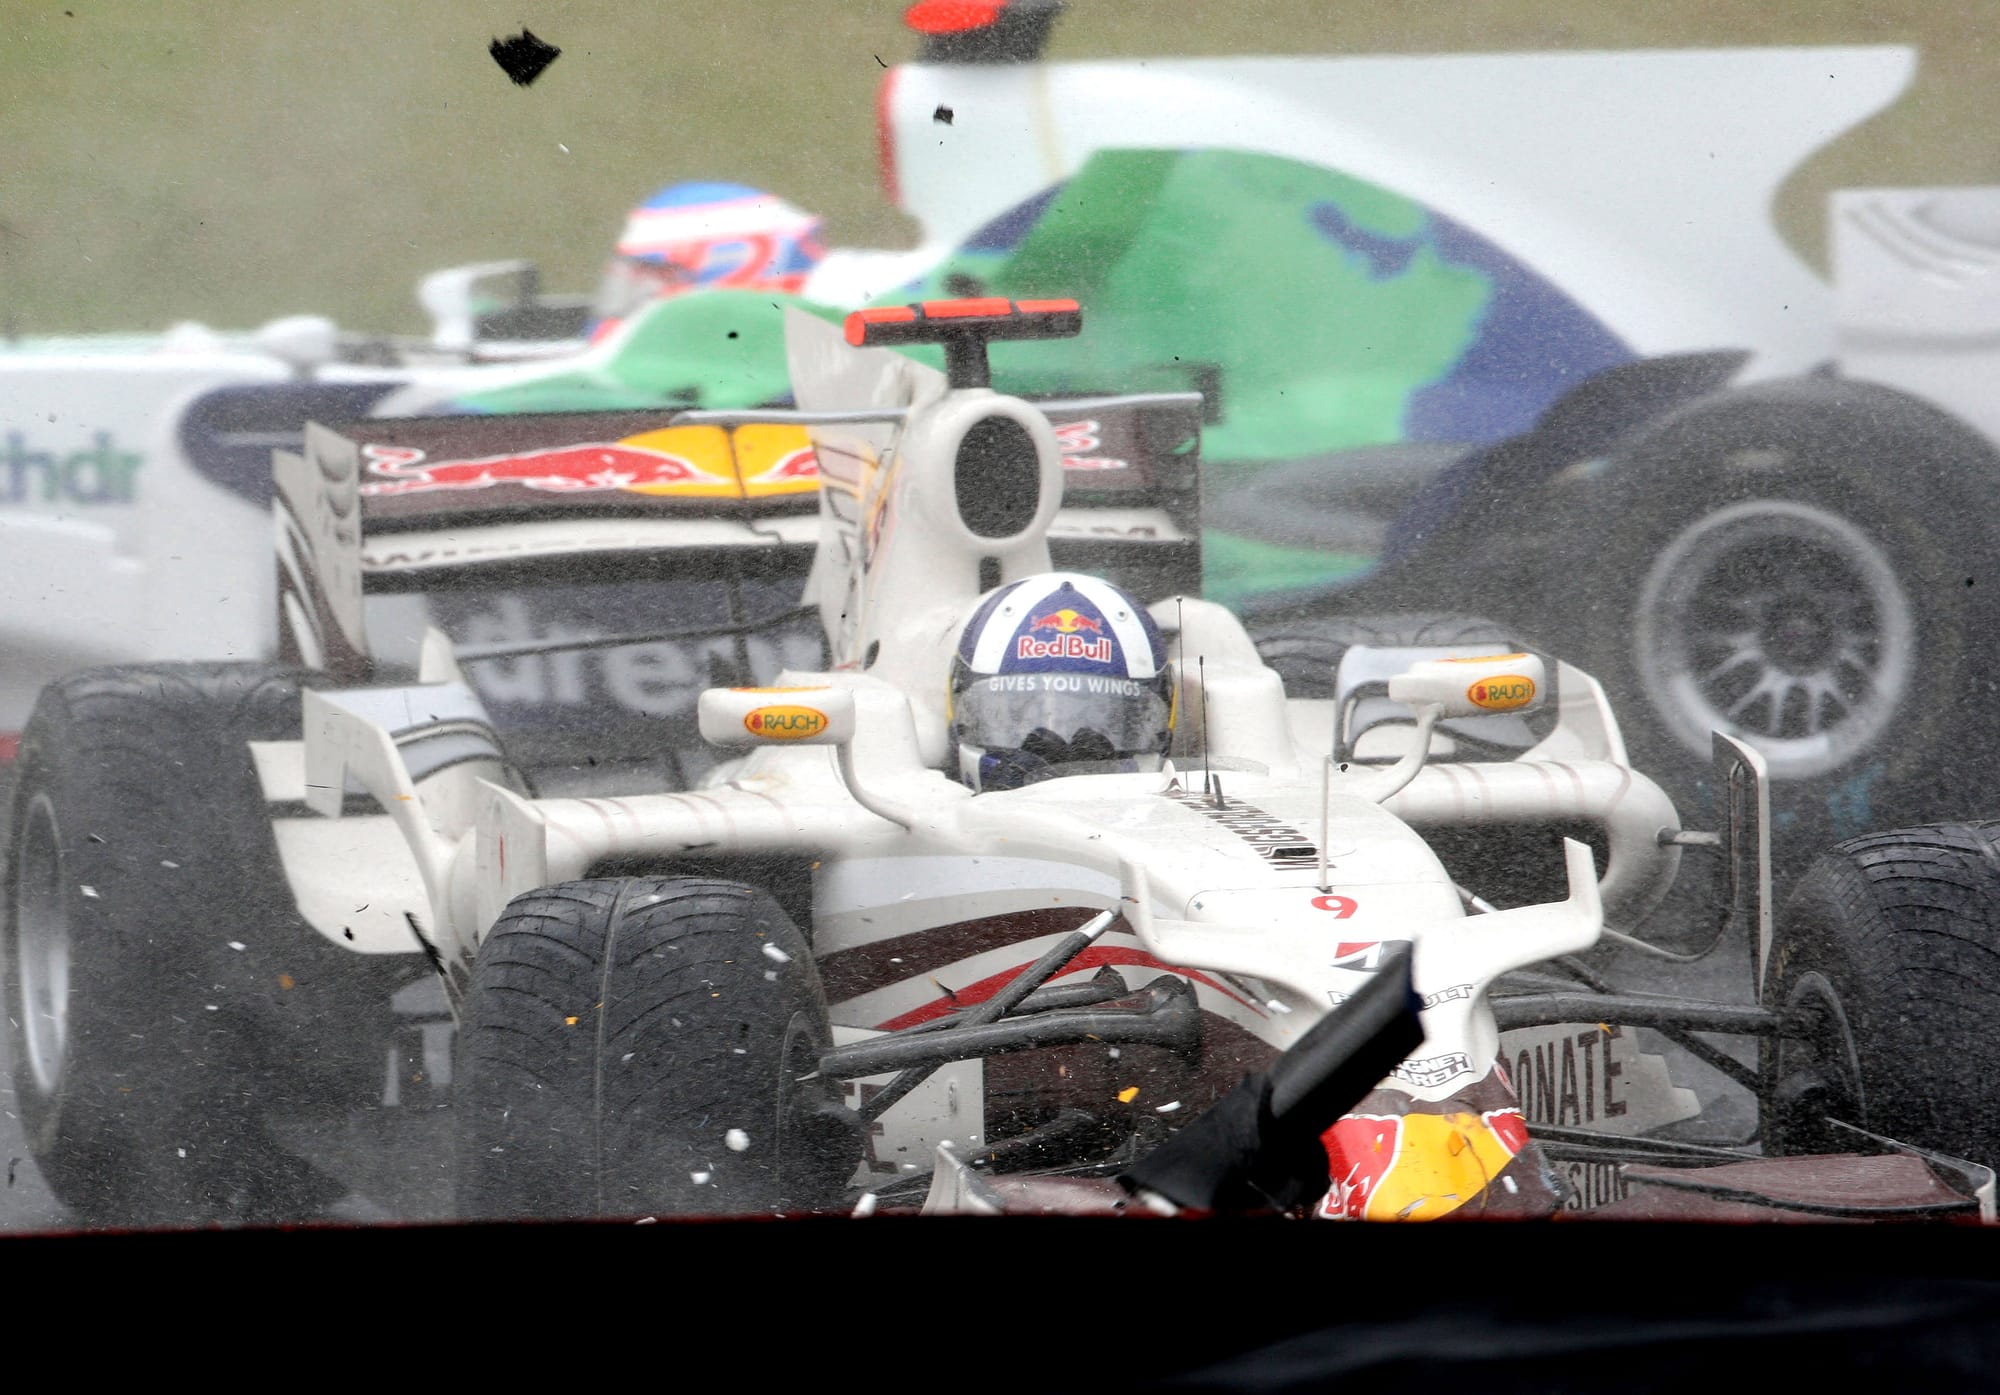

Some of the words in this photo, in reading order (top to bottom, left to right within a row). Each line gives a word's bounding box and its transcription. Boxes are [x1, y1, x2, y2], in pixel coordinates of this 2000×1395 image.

[1018, 633, 1065, 660] Red
[1066, 635, 1112, 664] Bull
[989, 676, 1034, 692] GIVES
[1043, 676, 1080, 692] YOU
[1088, 678, 1141, 697] WINGS
[764, 714, 818, 730] RAUCH
[1311, 895, 1358, 919] 9
